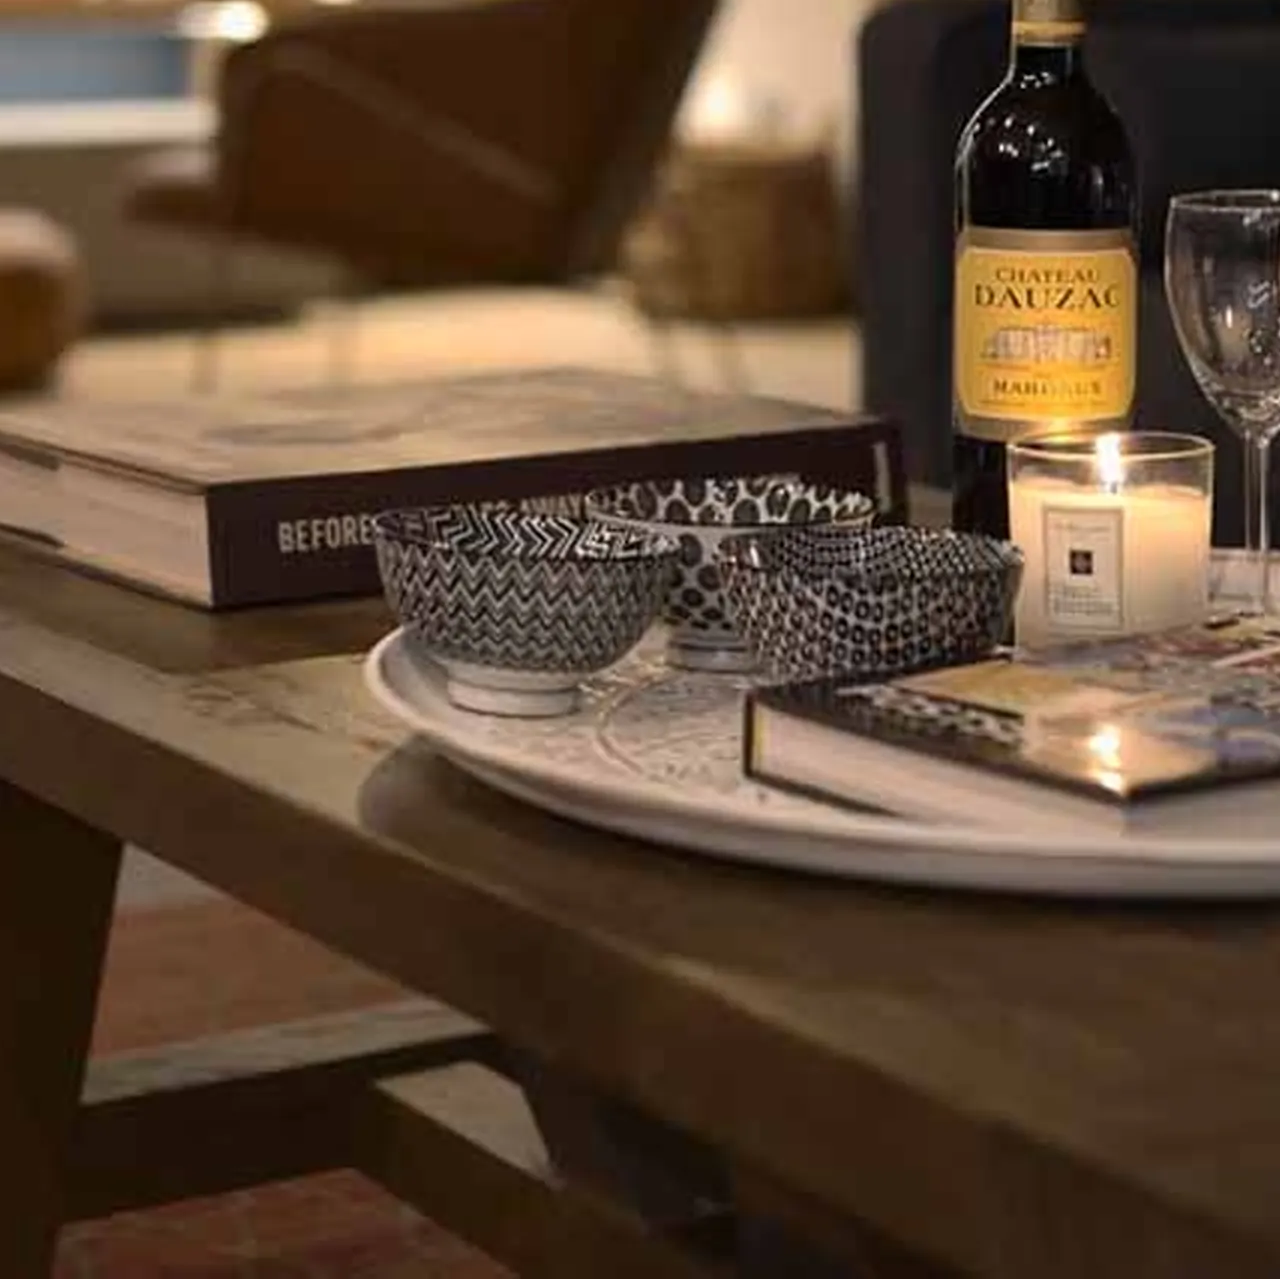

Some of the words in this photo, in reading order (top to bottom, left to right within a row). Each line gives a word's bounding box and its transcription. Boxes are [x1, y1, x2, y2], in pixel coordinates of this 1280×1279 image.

[995, 267, 1100, 284] CHATEAU
[974, 283, 1121, 309] DAUZAC
[278, 513, 375, 553] BEFORE
